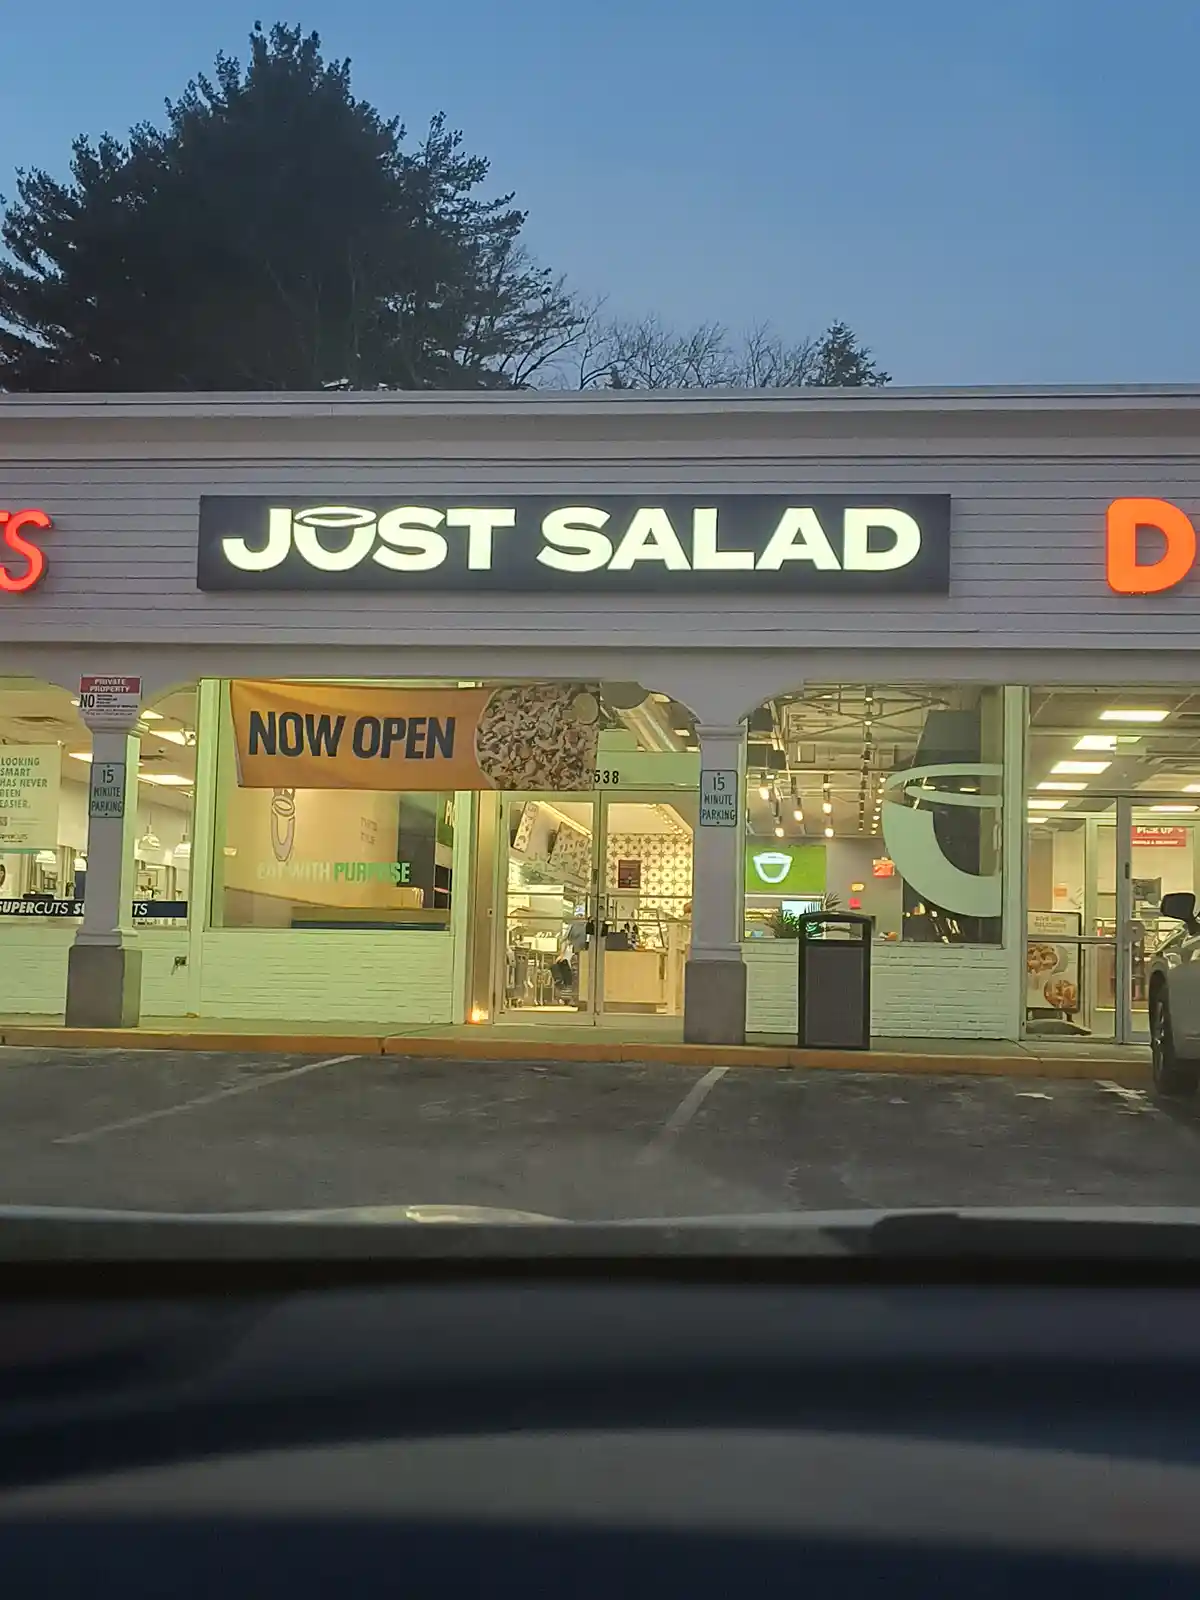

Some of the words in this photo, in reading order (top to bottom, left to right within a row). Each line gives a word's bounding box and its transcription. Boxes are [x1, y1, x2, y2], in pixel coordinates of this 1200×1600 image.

[221, 505, 516, 572] JUST
[536, 506, 922, 573] SALAD
[1107, 498, 1196, 593] D
[80, 694, 95, 708] NO
[248, 711, 347, 757] NOW
[352, 715, 456, 760] OPEN
[1, 757, 40, 766] LOOKING
[0, 767, 31, 777] SMART
[102, 769, 115, 783] 15
[594, 769, 620, 785] 538
[0, 778, 17, 788] HAS
[20, 778, 48, 788] NEVER
[713, 776, 725, 791] 15
[94, 786, 121, 798] MINUTE
[91, 800, 122, 813] PARKING
[704, 794, 732, 806] MINUTE
[702, 808, 736, 821] PARKING
[286, 863, 330, 881] WITH
[333, 861, 411, 883] PURPOSE
